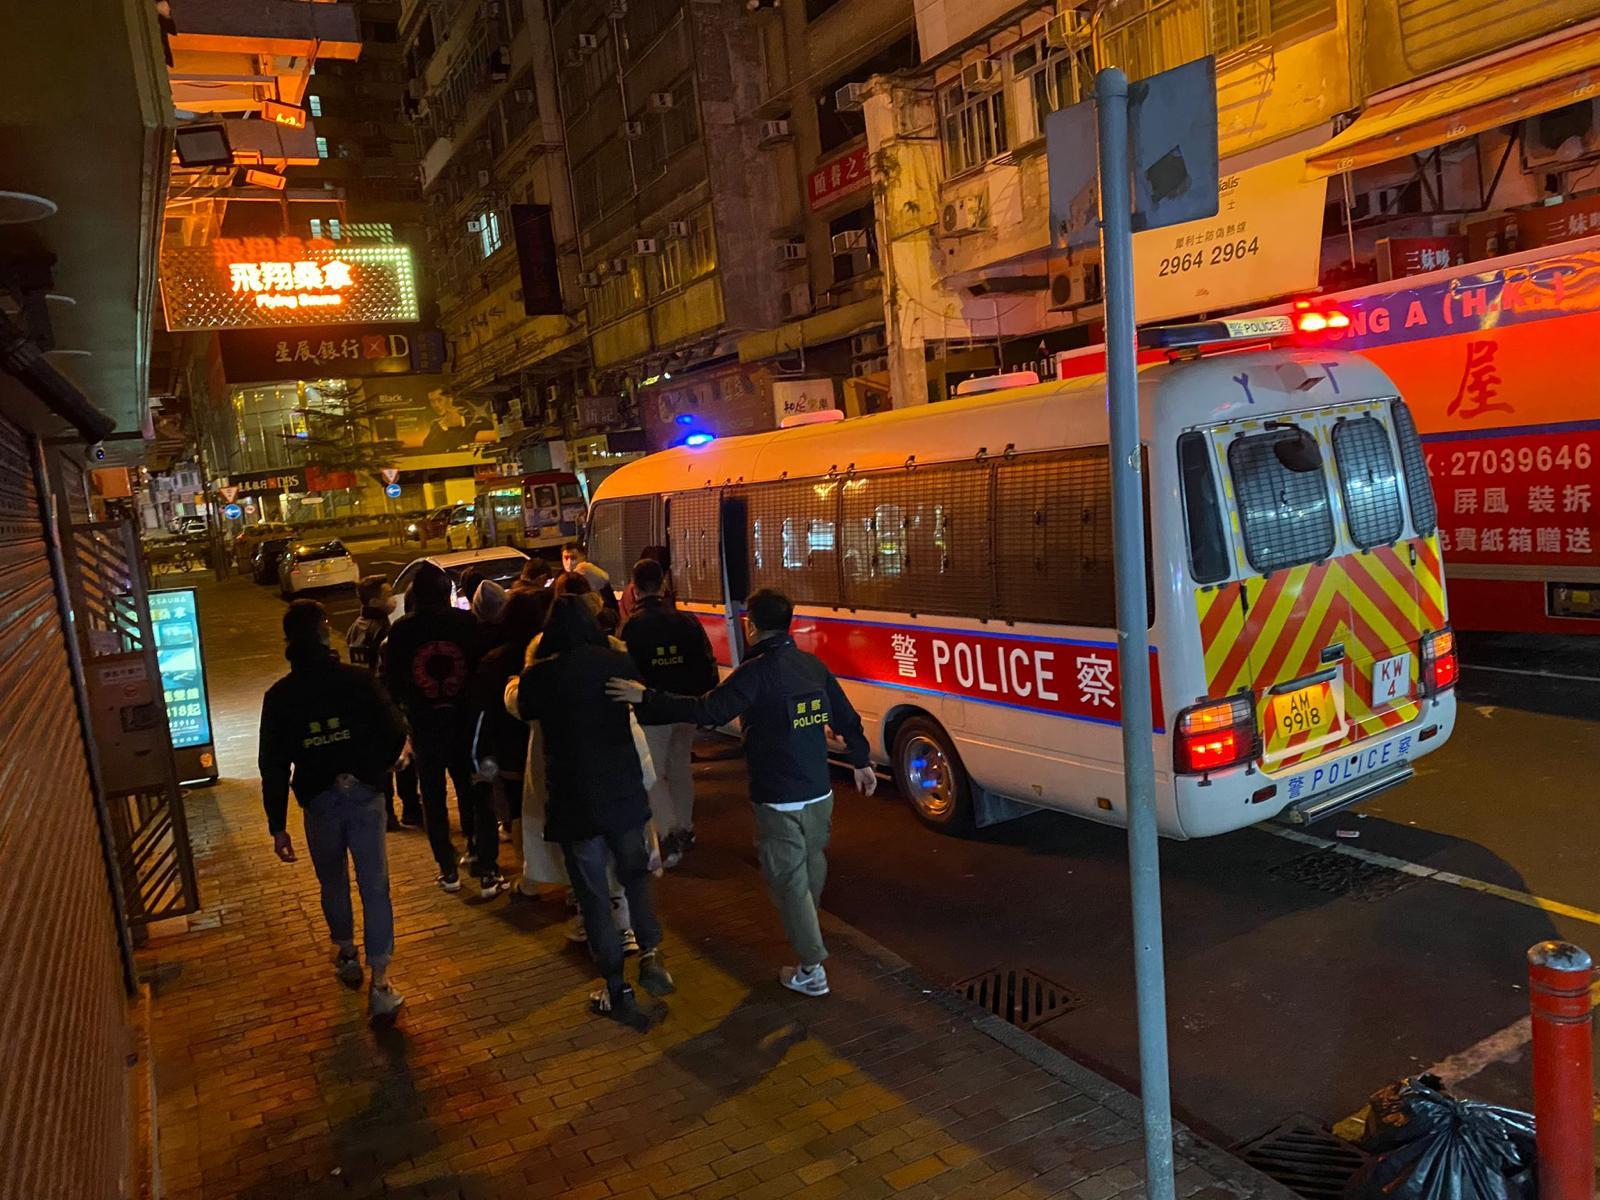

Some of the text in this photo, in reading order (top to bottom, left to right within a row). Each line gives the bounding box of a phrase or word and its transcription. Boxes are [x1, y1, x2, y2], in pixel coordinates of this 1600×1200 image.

[1219, 176, 1240, 192] ialis
[1159, 236, 1260, 278] 2964 2964
[229, 260, 353, 293] 飛翔桑拿
[1404, 300, 1429, 328] A
[1244, 321, 1278, 336] POLICE
[1447, 340, 1515, 420] 屋
[1453, 484, 1592, 514] 屏風 裝拆
[652, 655, 684, 666] POLICE
[890, 633, 919, 678] 警
[932, 639, 1059, 701] POLICE
[1076, 653, 1116, 708] 察
[1381, 657, 1404, 683] KW
[1387, 680, 1396, 698] 4
[1290, 692, 1311, 714] AM
[793, 712, 829, 729] POLICE
[1283, 707, 1321, 733] 9918
[303, 729, 351, 749] POLICE
[1311, 742, 1392, 792] POLICE
